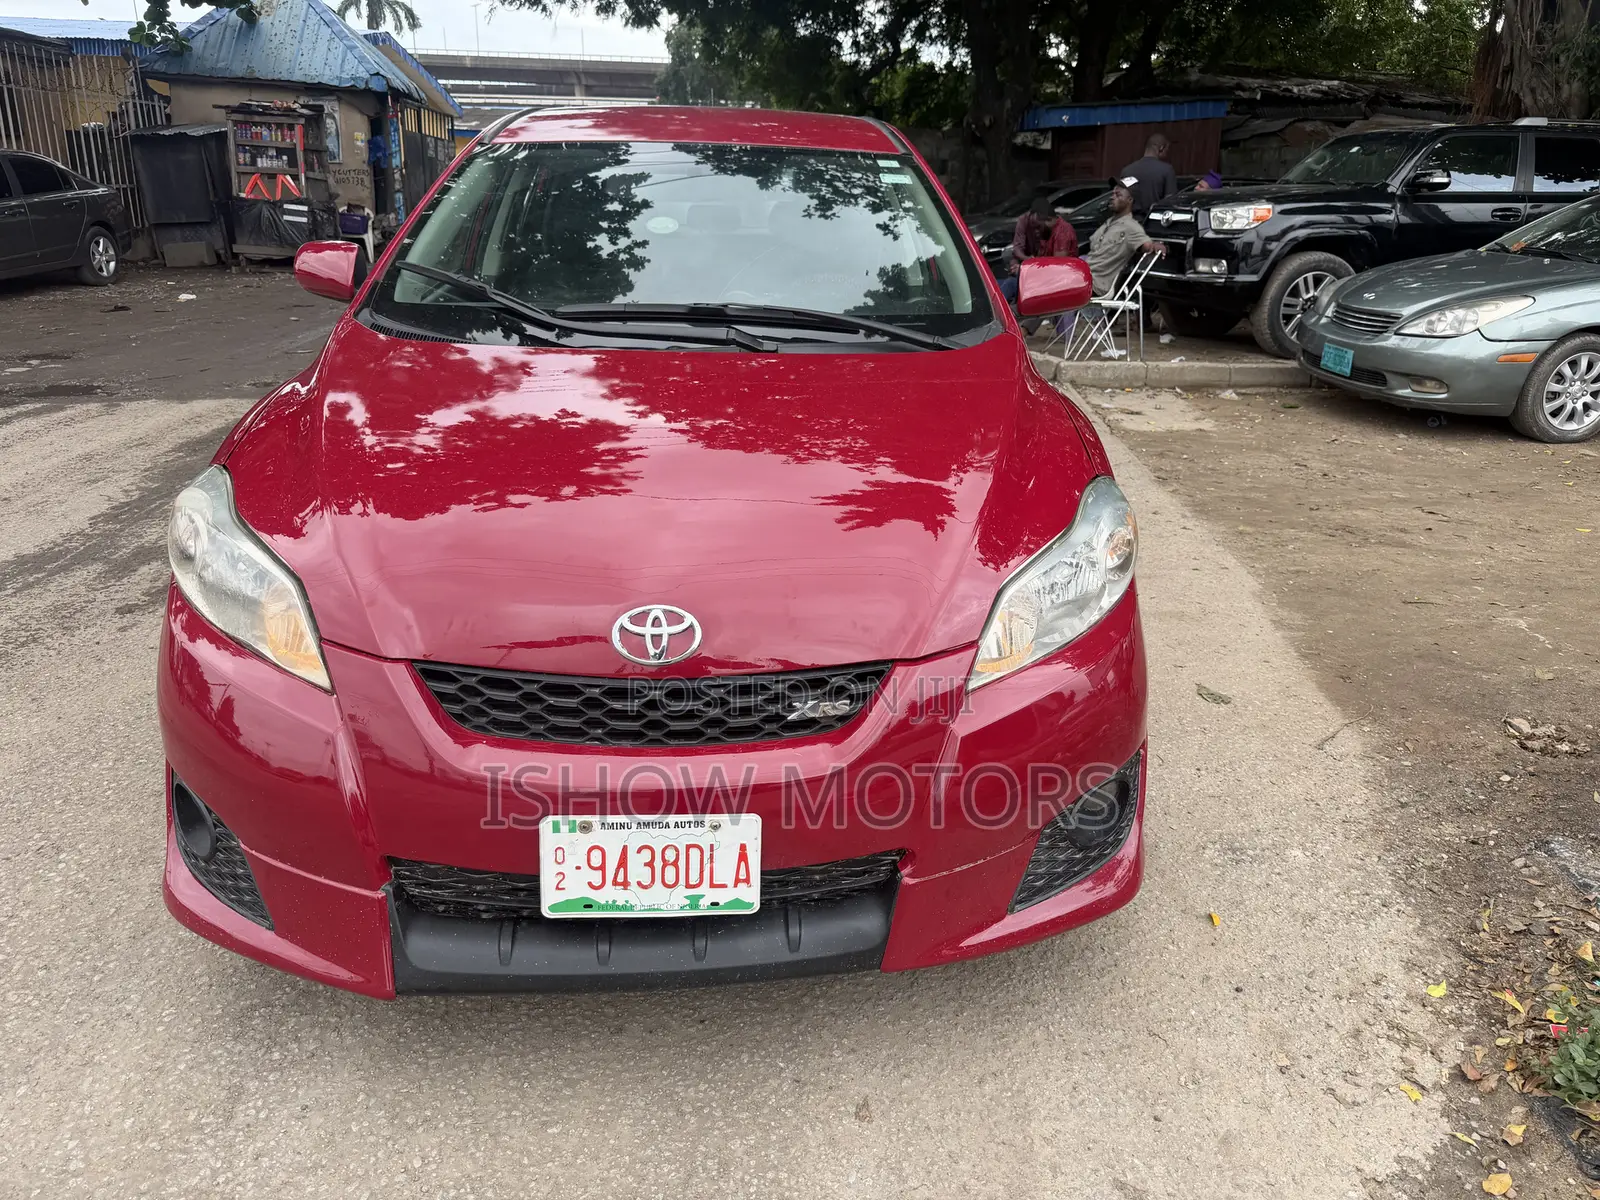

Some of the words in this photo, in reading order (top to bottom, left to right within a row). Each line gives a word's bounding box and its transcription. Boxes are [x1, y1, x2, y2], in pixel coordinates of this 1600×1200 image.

[787, 700, 850, 720] XRS
[600, 821, 632, 830] AMINU
[636, 821, 670, 830] AMUDA
[673, 820, 705, 829] AUTOS
